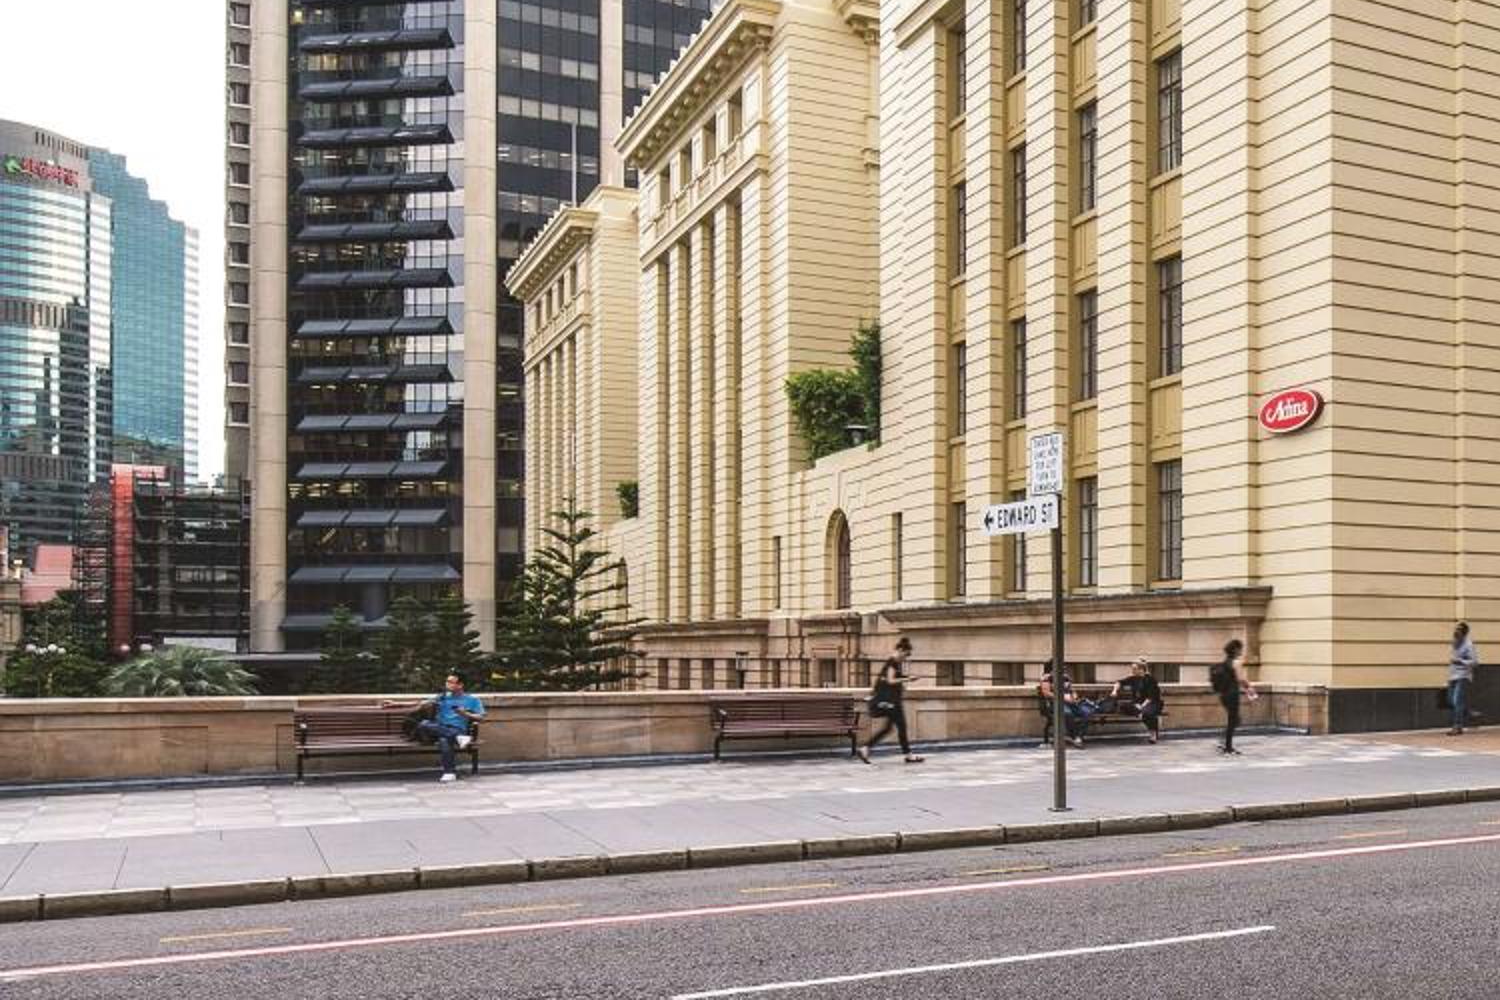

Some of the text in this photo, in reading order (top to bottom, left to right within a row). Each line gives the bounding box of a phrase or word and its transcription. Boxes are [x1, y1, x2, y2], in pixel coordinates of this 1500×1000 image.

[1265, 397, 1308, 424] Adina
[997, 501, 1053, 529] EDWARD ST
